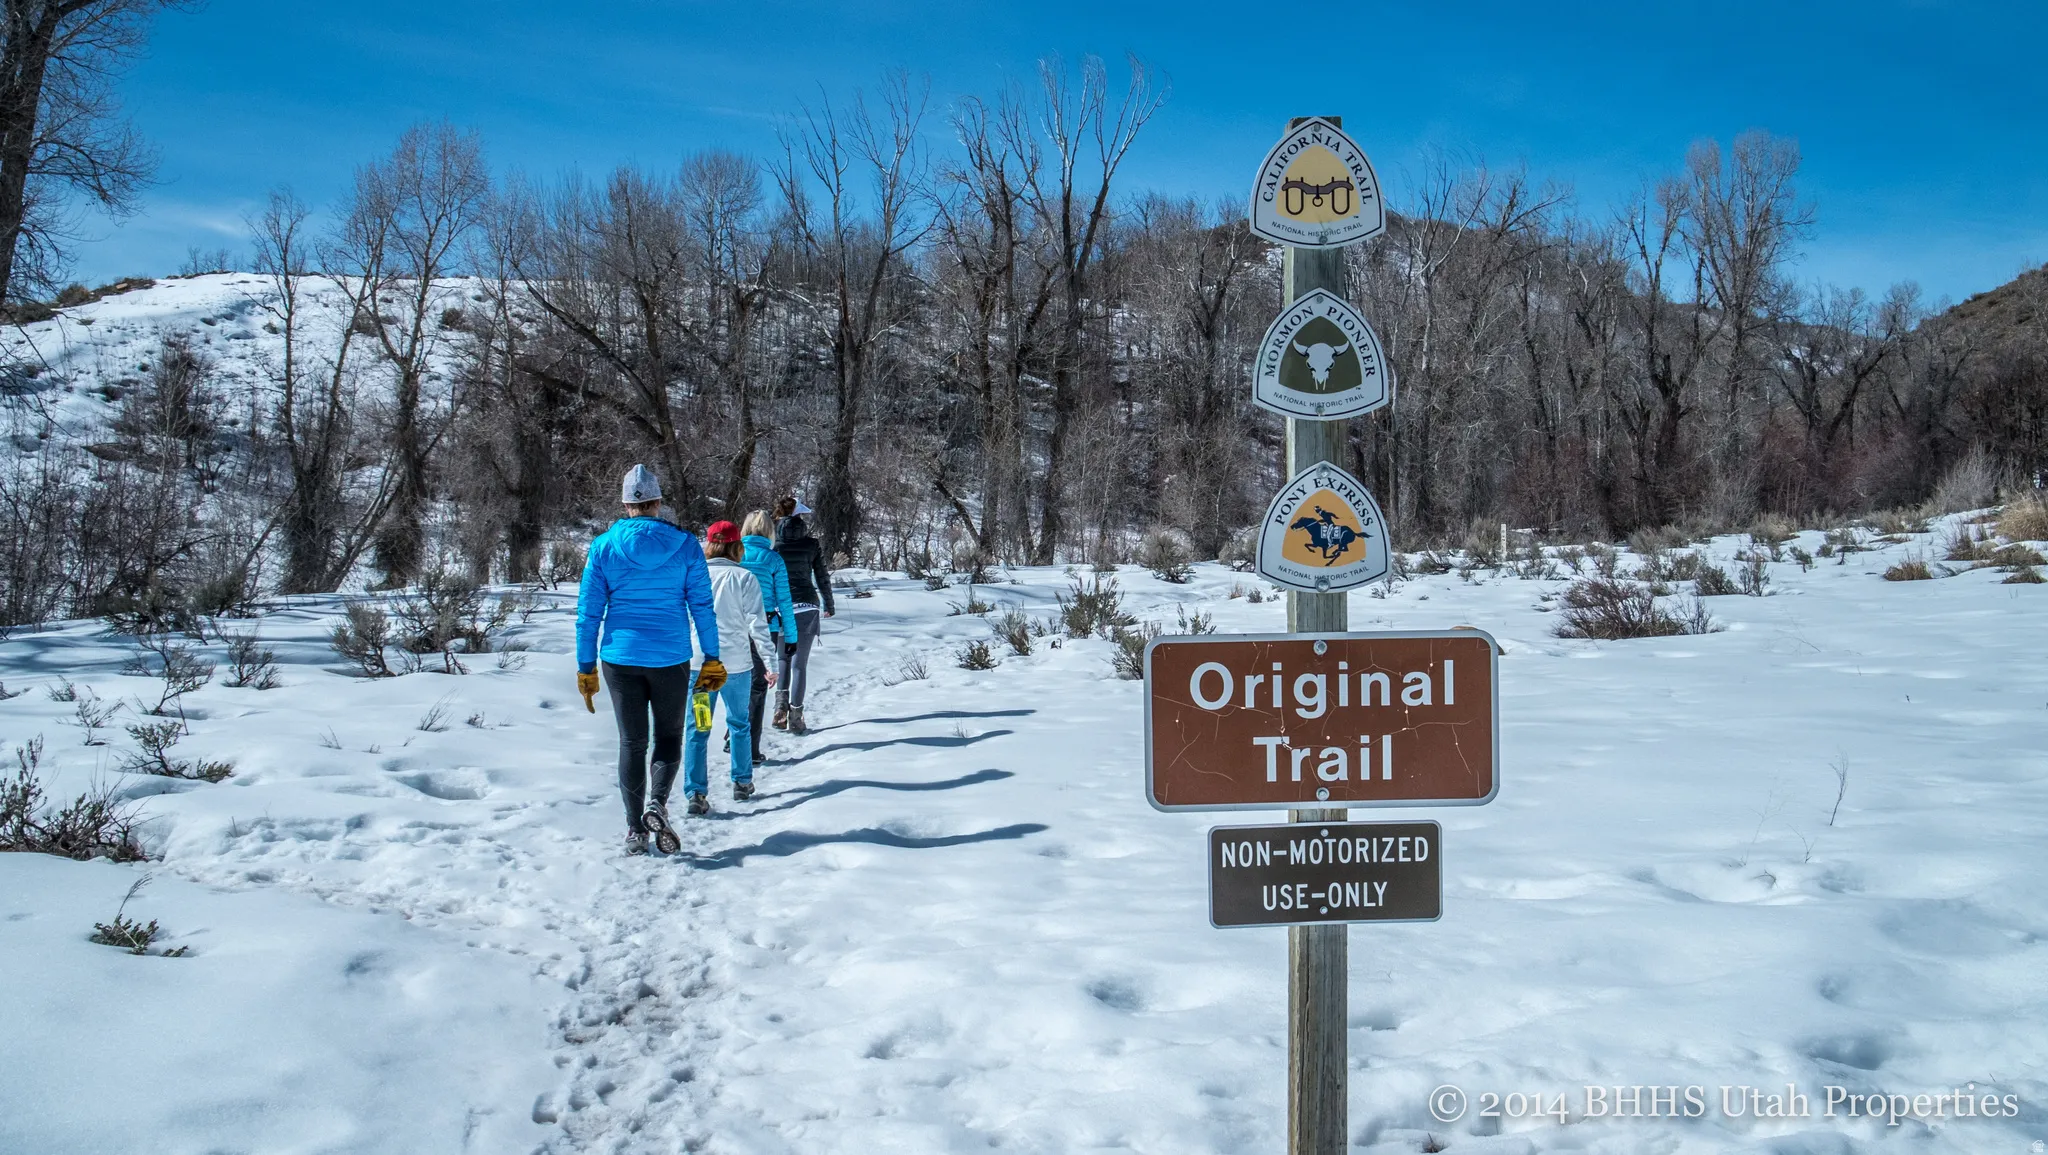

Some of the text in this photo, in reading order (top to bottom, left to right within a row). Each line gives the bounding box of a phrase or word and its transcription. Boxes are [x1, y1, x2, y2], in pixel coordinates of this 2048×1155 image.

[1263, 132, 1373, 205] CALIFORNIA TRAIL
[1271, 221, 1363, 238] NATIONAL HISTORIC TRAIL
[1264, 305, 1376, 378] MORMON PIONEER
[1273, 391, 1365, 409] NATIONAL HISTORIC TRAIL
[1274, 477, 1374, 527] PONY EXPRESS
[1278, 565, 1370, 581] NATIONAL HISTORIC TRAIL
[1189, 659, 1454, 719] Original
[1252, 734, 1393, 782] Trail
[1221, 836, 1429, 868] NON-MOTORIZED
[1262, 881, 1388, 911] USE-ONLY
